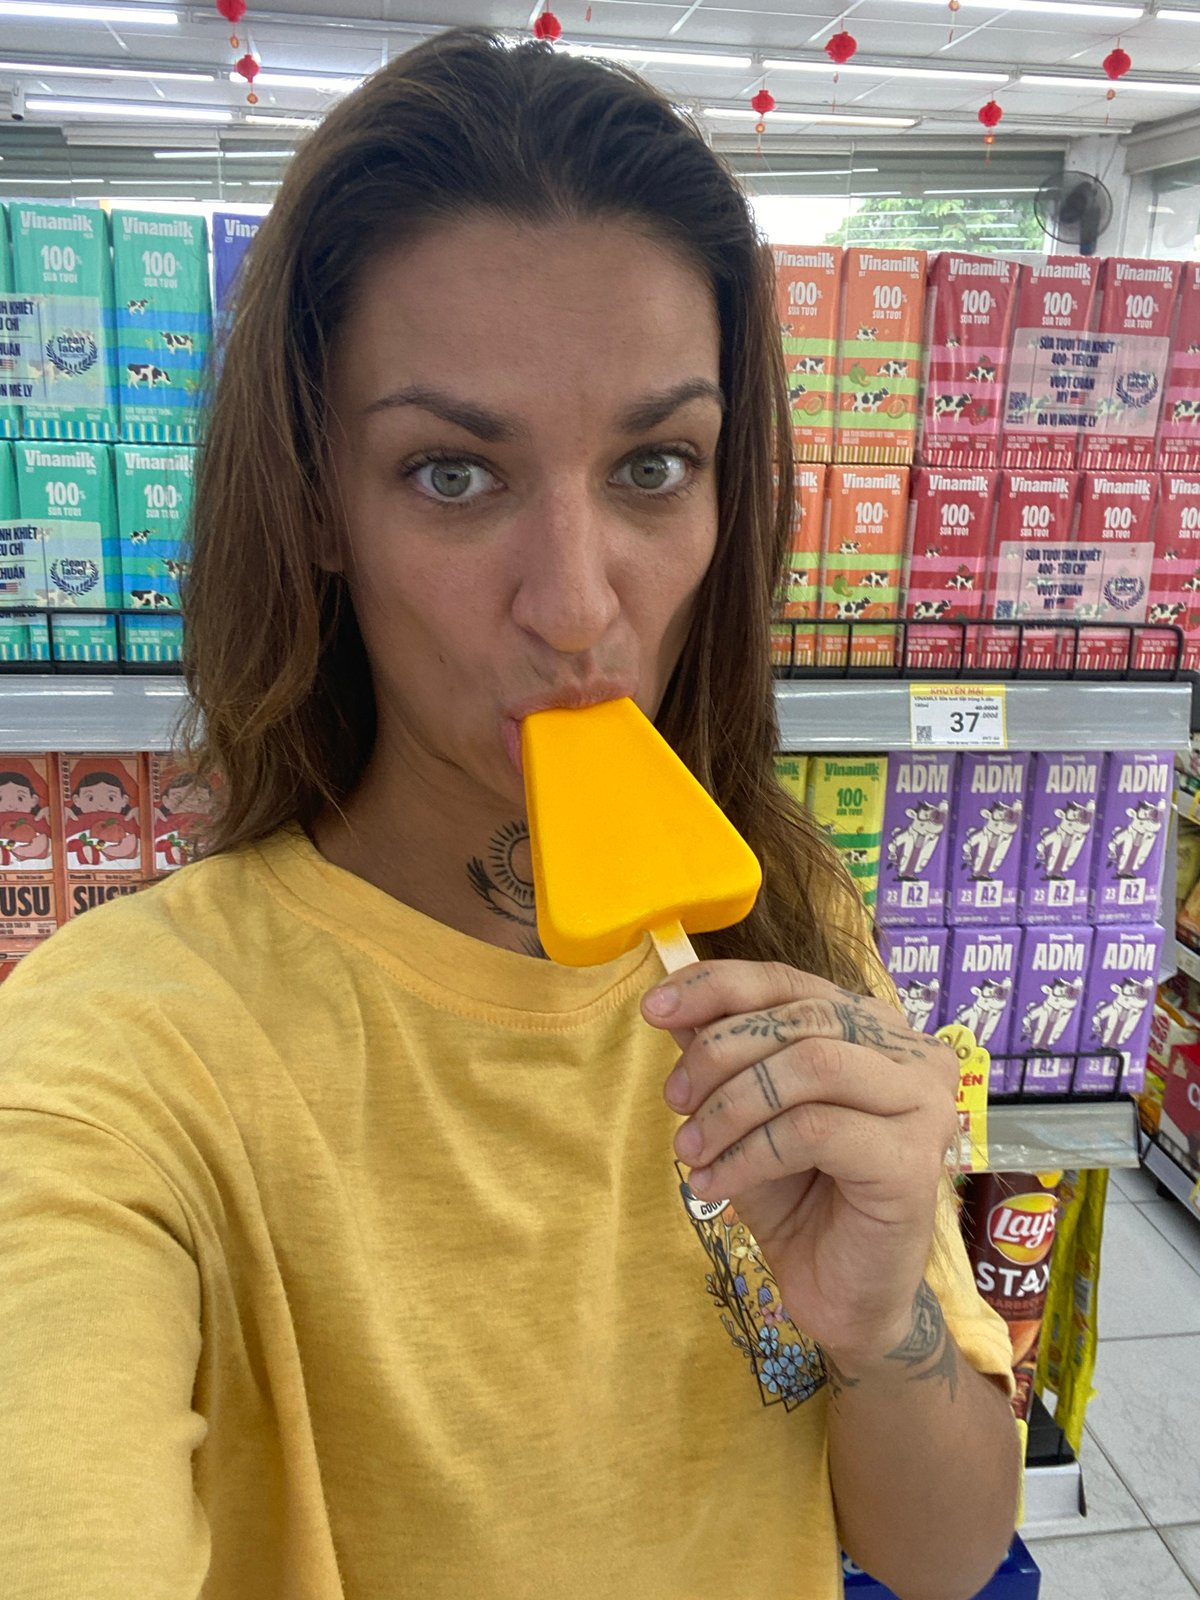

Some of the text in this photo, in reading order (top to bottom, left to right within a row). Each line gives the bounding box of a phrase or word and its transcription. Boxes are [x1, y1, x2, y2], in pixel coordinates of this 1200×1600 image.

[21, 211, 93, 232] Vinamilk
[122, 217, 193, 238] Vinamilk
[224, 219, 258, 238] Vina
[859, 255, 919, 273] Vinamilk
[950, 258, 1010, 277] Vinamilk
[1116, 264, 1173, 282] Vinamilk
[57, 335, 85, 345] clean
[58, 343, 85, 353] label
[25, 450, 96, 469] Vinamilk
[843, 473, 900, 489] Vinamilk
[930, 475, 989, 491] Vinamilk
[1011, 477, 1069, 493] Vinamilk
[1094, 479, 1150, 495] Vinamilk
[1171, 479, 1200, 494] Vina
[0, 528, 11, 541] NH
[61, 557, 86, 567] clean
[62, 565, 87, 576] label
[950, 712, 980, 733] 37
[776, 762, 799, 776] milk
[826, 763, 880, 776] Vinamilk
[896, 764, 949, 793] ADM
[971, 765, 1023, 793] ADM
[1046, 765, 1097, 793] ADM
[1118, 764, 1168, 793] ADM
[907, 885, 923, 902] A2
[981, 885, 997, 902] A2
[1054, 885, 1070, 901] A2
[1124, 884, 1139, 900] A2
[0, 886, 50, 917] USU
[888, 946, 940, 973] ADM
[962, 944, 1013, 972] ADM
[1033, 944, 1085, 971] ADM
[1103, 944, 1156, 971] ADM
